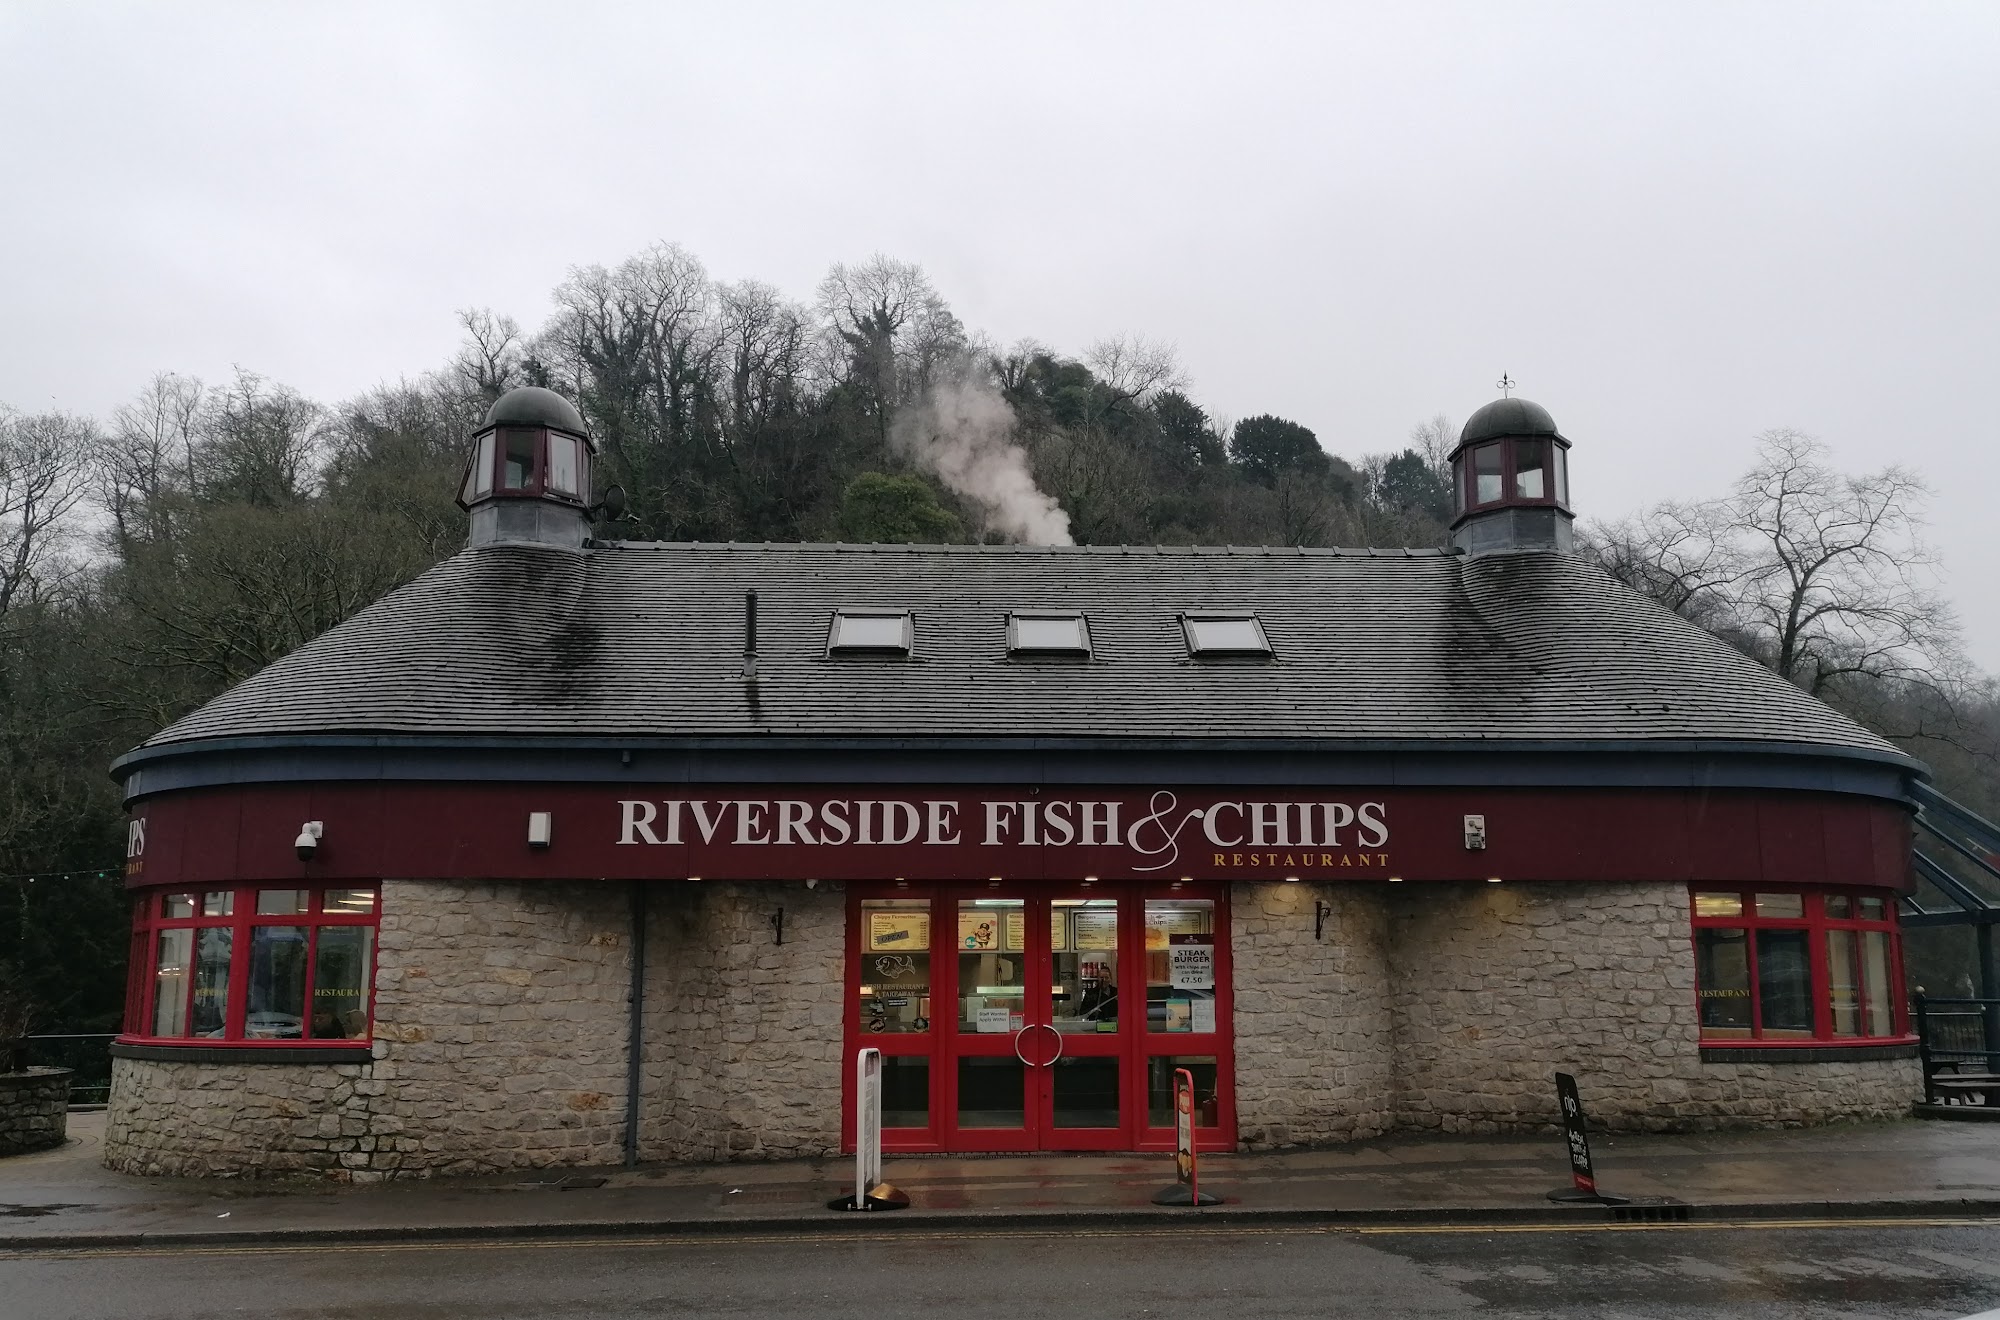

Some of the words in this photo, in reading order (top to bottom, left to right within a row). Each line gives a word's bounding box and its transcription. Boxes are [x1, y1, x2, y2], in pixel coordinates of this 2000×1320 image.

[616, 800, 962, 846] RIVERSIDE
[980, 800, 1124, 846] FISH
[1127, 790, 1205, 871] &
[1204, 801, 1389, 848] CHIPS
[1213, 853, 1389, 867] RESTAURANT
[882, 983, 925, 991] RESTAURANT
